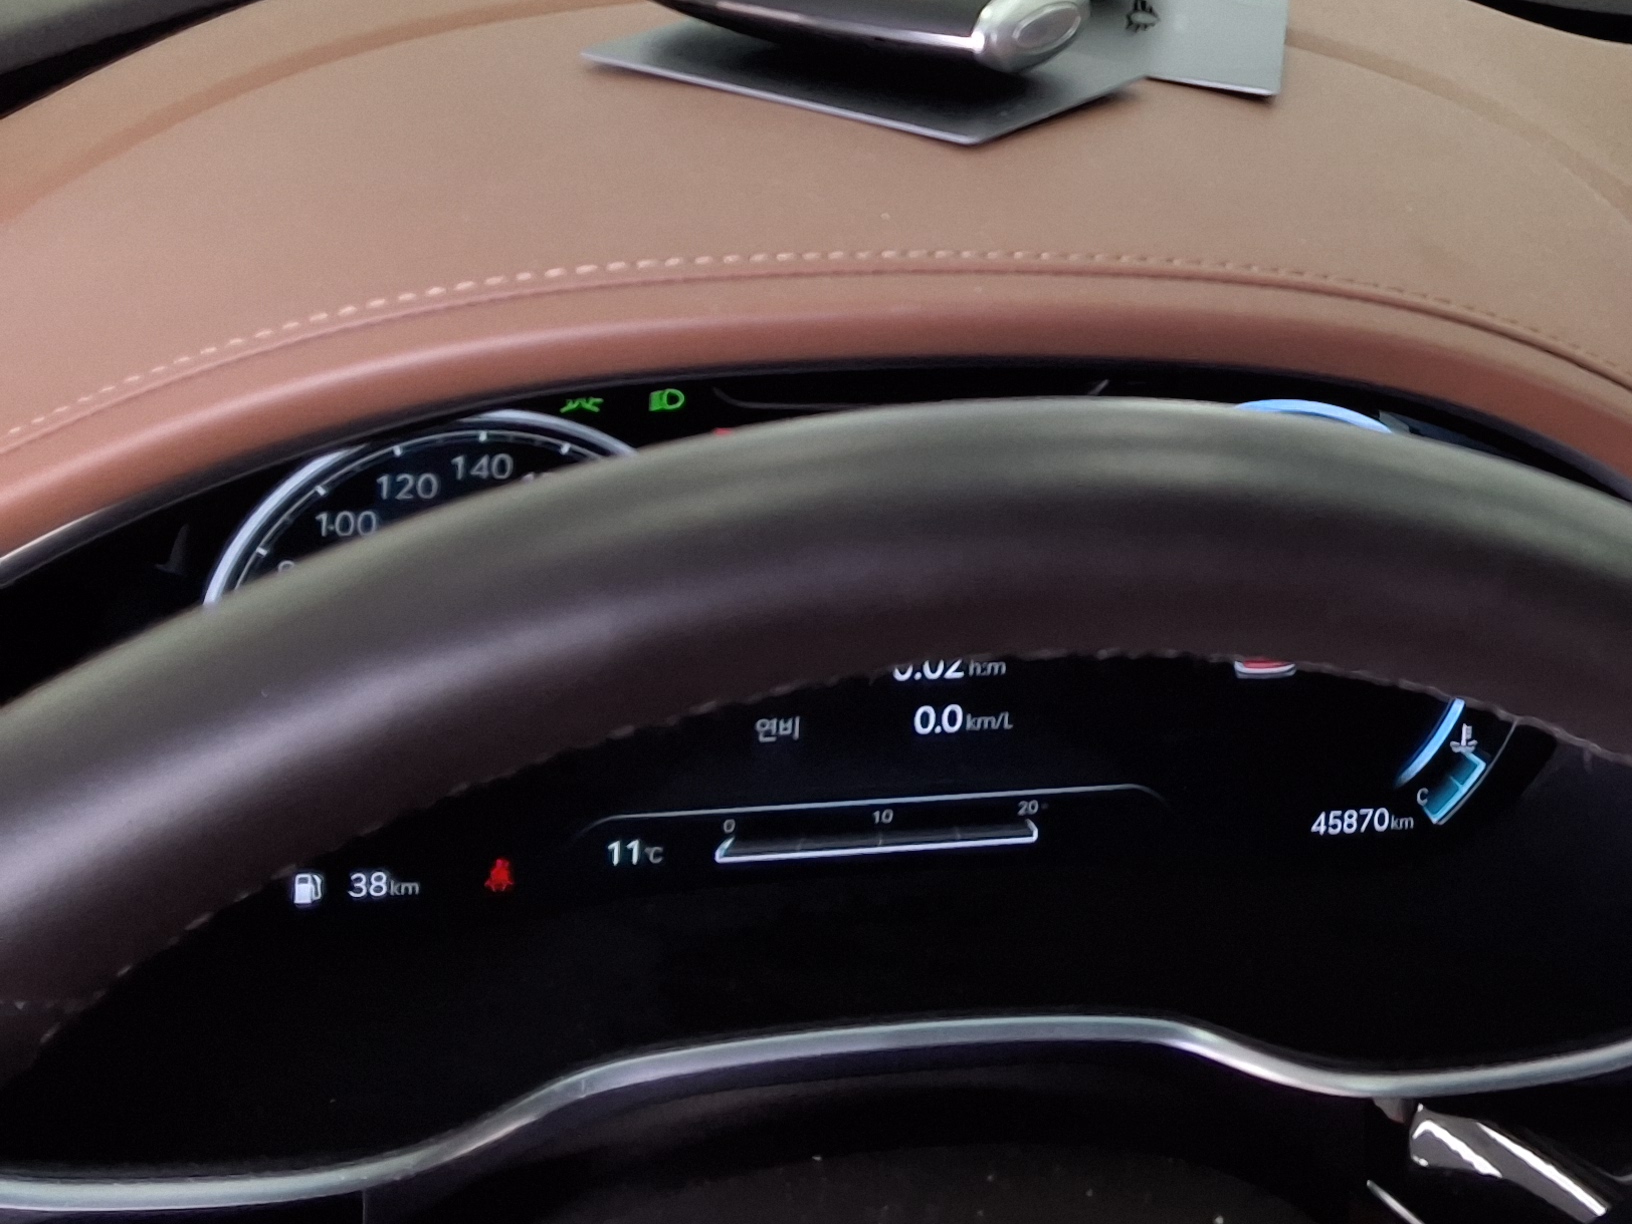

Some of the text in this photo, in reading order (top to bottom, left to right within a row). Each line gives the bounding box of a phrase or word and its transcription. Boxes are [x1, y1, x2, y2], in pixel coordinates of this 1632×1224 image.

[451, 452, 514, 481] 140
[376, 473, 440, 501] 120
[315, 509, 378, 538] 100
[755, 716, 800, 743] 연비
[1018, 799, 1039, 816] 20
[1416, 788, 1429, 806] C
[723, 819, 735, 833] 0
[872, 809, 894, 825] 10
